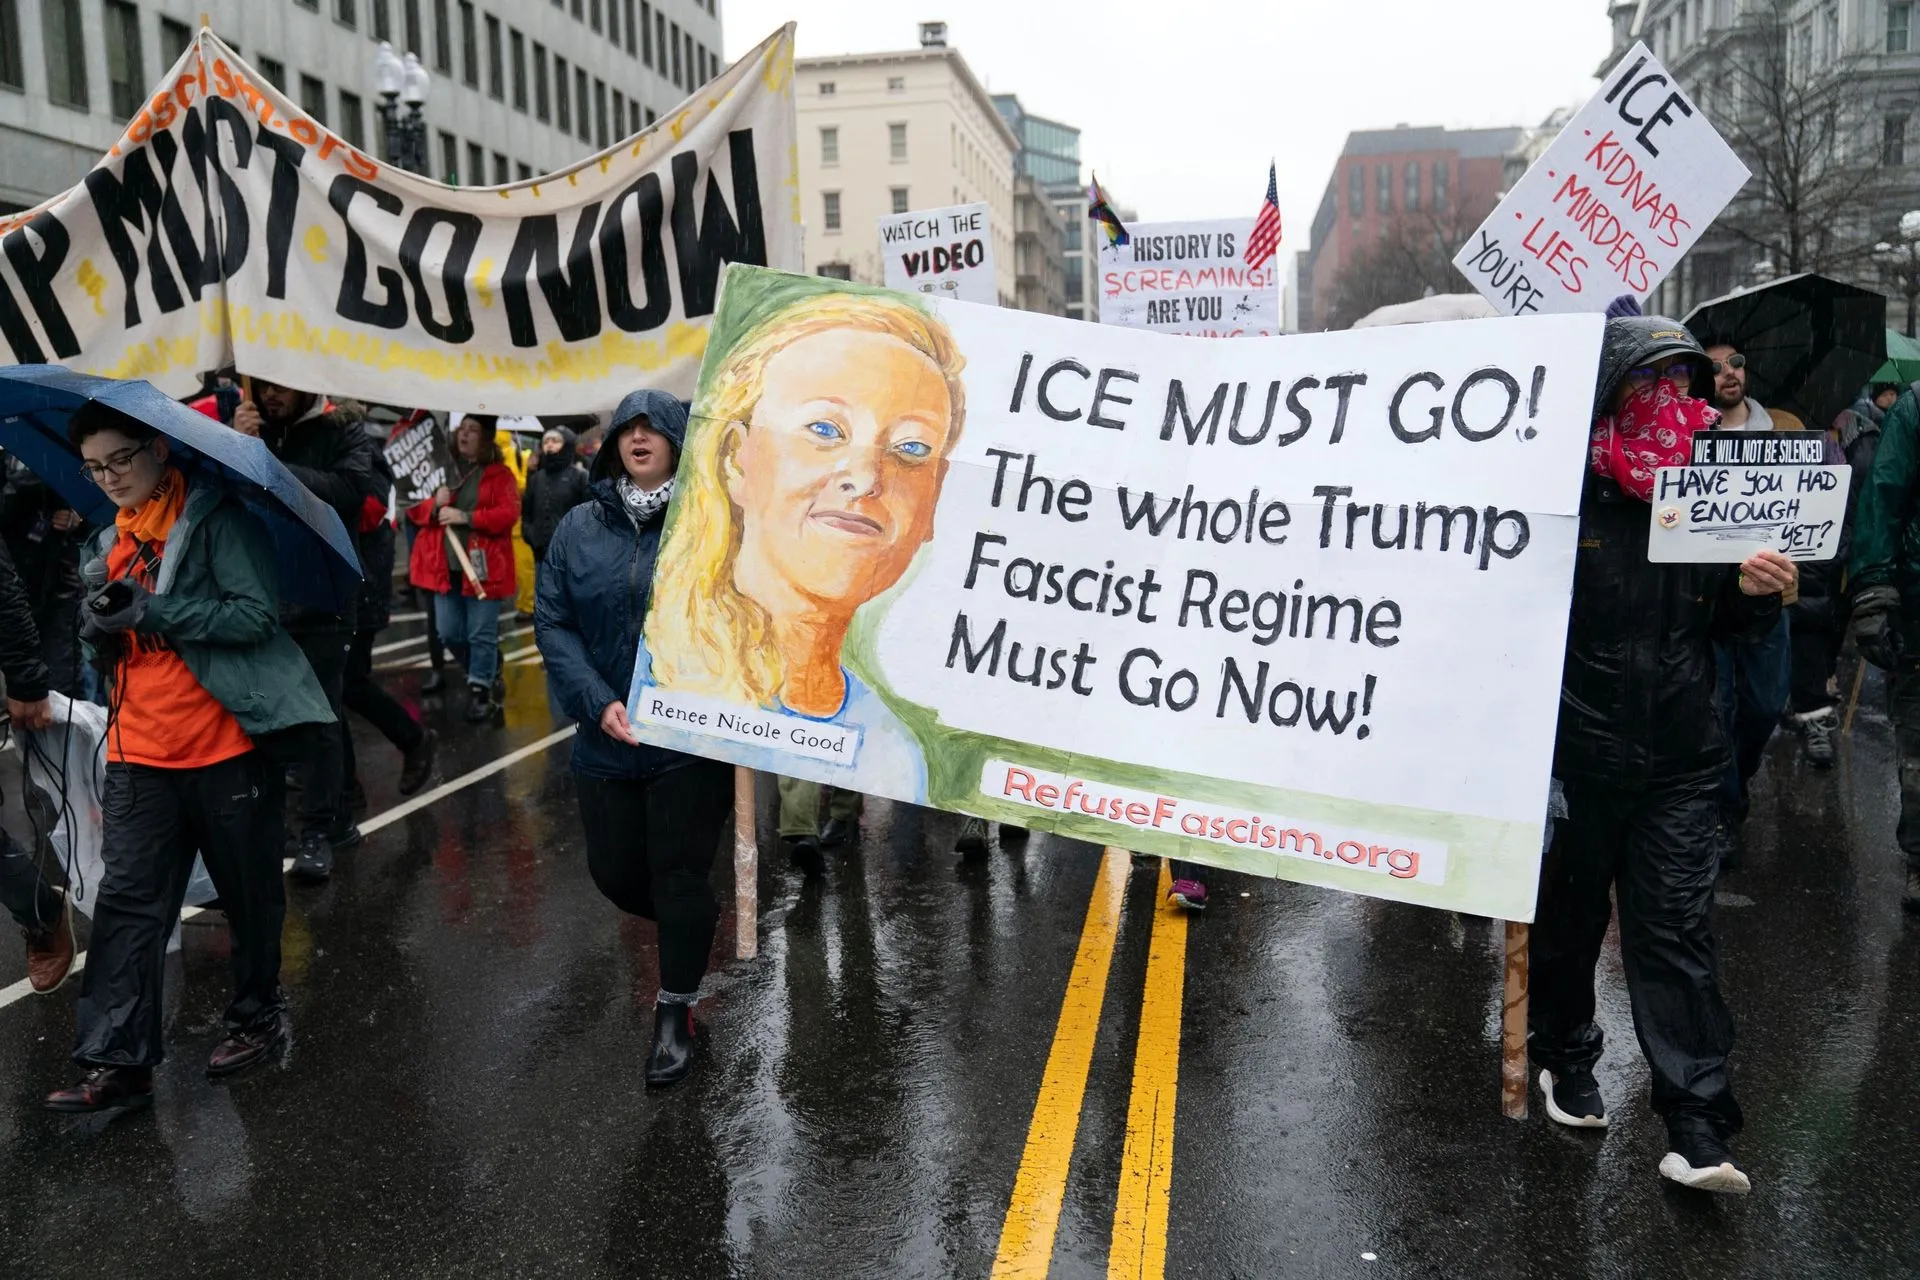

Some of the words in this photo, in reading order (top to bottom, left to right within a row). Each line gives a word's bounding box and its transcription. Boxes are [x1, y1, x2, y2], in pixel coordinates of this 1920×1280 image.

[110, 43, 379, 181] ascism.org
[1604, 56, 1693, 158] ICE
[1585, 130, 1691, 247] KIDNAPS
[85, 95, 305, 330] MUST
[328, 173, 483, 343] GO
[501, 128, 767, 347] NOW
[882, 215, 940, 246] WATCH
[953, 212, 983, 233] THE
[1133, 233, 1209, 262] HISTORY
[1217, 233, 1235, 258] IS
[1553, 174, 1659, 292] MURDERS
[901, 238, 984, 278] VIDEO
[1104, 267, 1272, 296] SCREAMING!
[1522, 217, 1588, 293] LIES
[1146, 299, 1181, 325] ARE
[1185, 296, 1222, 321] YOU
[1009, 352, 1140, 431] ICE
[1159, 372, 1368, 446] MUST
[1388, 365, 1547, 443] GO!
[382, 417, 435, 465] TRUMP
[392, 435, 434, 479] MUST
[1694, 439, 1711, 463] WE
[1716, 440, 1739, 463] WILL
[1742, 440, 1763, 463] NOT
[1764, 440, 1779, 463] BE
[1779, 439, 1823, 463] SILENCED
[411, 459, 431, 487] GO
[1660, 468, 1729, 501] HAVE
[1797, 470, 1838, 492] HAD
[985, 448, 1093, 522] The
[1117, 484, 1291, 546] whole
[1312, 485, 1531, 571] Trump
[1690, 498, 1801, 522] ENOUGH
[964, 530, 1163, 624] Fascist
[1178, 567, 1402, 648] Regime
[944, 610, 1098, 696] Must
[1118, 647, 1200, 712] Go
[1215, 655, 1378, 740] Now!
[651, 699, 708, 726] Renee
[717, 712, 782, 740] Nicole
[790, 728, 846, 753] Good
[1003, 767, 1421, 879] RefuseFascism.org
